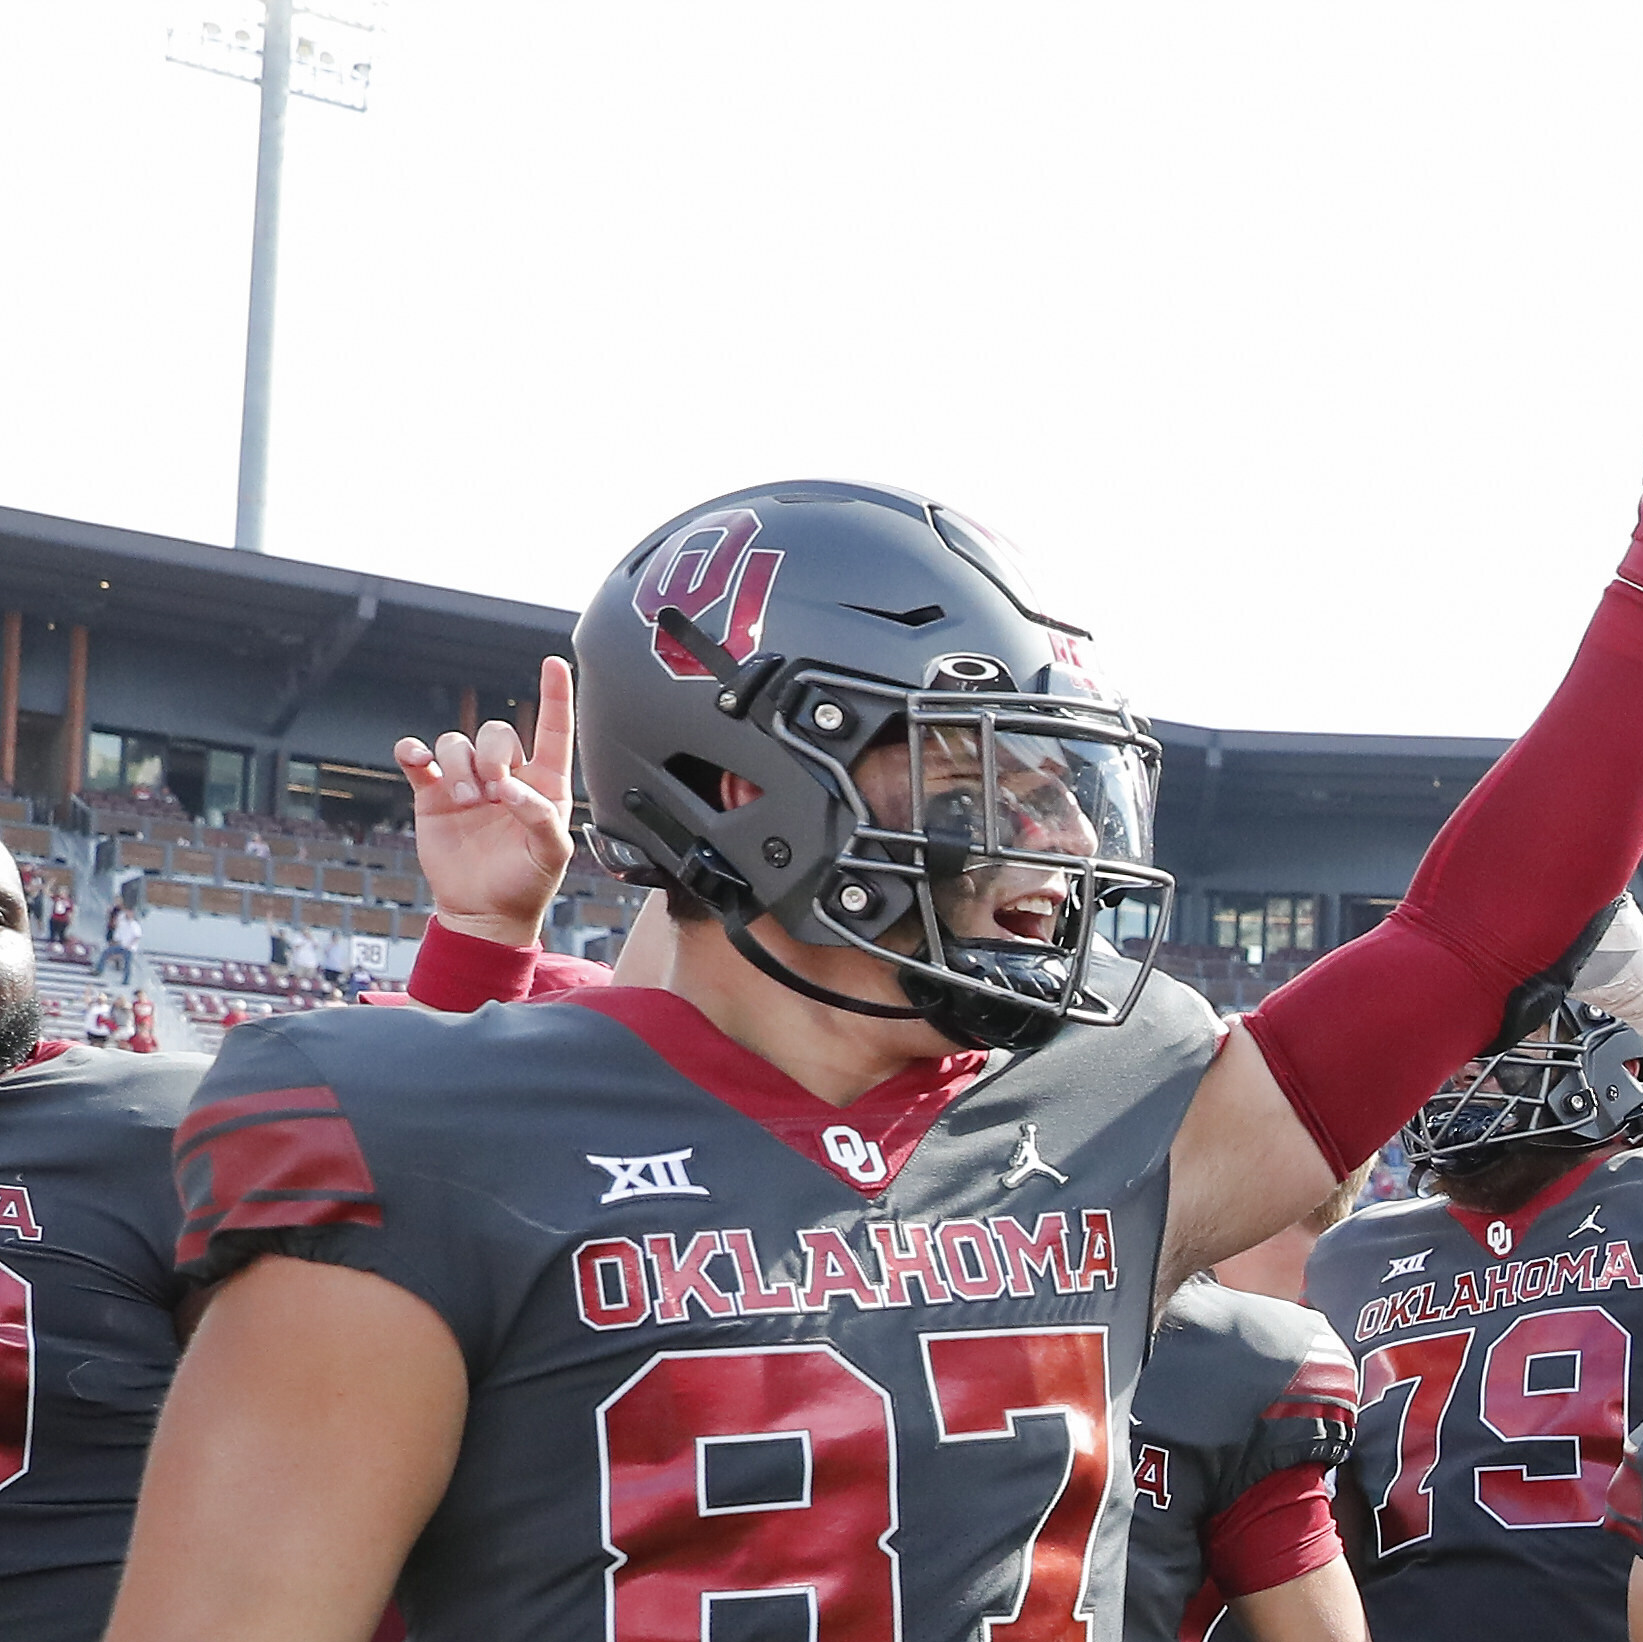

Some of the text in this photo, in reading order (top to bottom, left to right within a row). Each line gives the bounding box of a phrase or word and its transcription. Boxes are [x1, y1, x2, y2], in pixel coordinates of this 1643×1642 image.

[821, 1124, 888, 1185] OU
[571, 1208, 1119, 1333] OKLAHOMA
[1486, 1220, 1513, 1257] OU
[1356, 1304, 1633, 1560] 79
